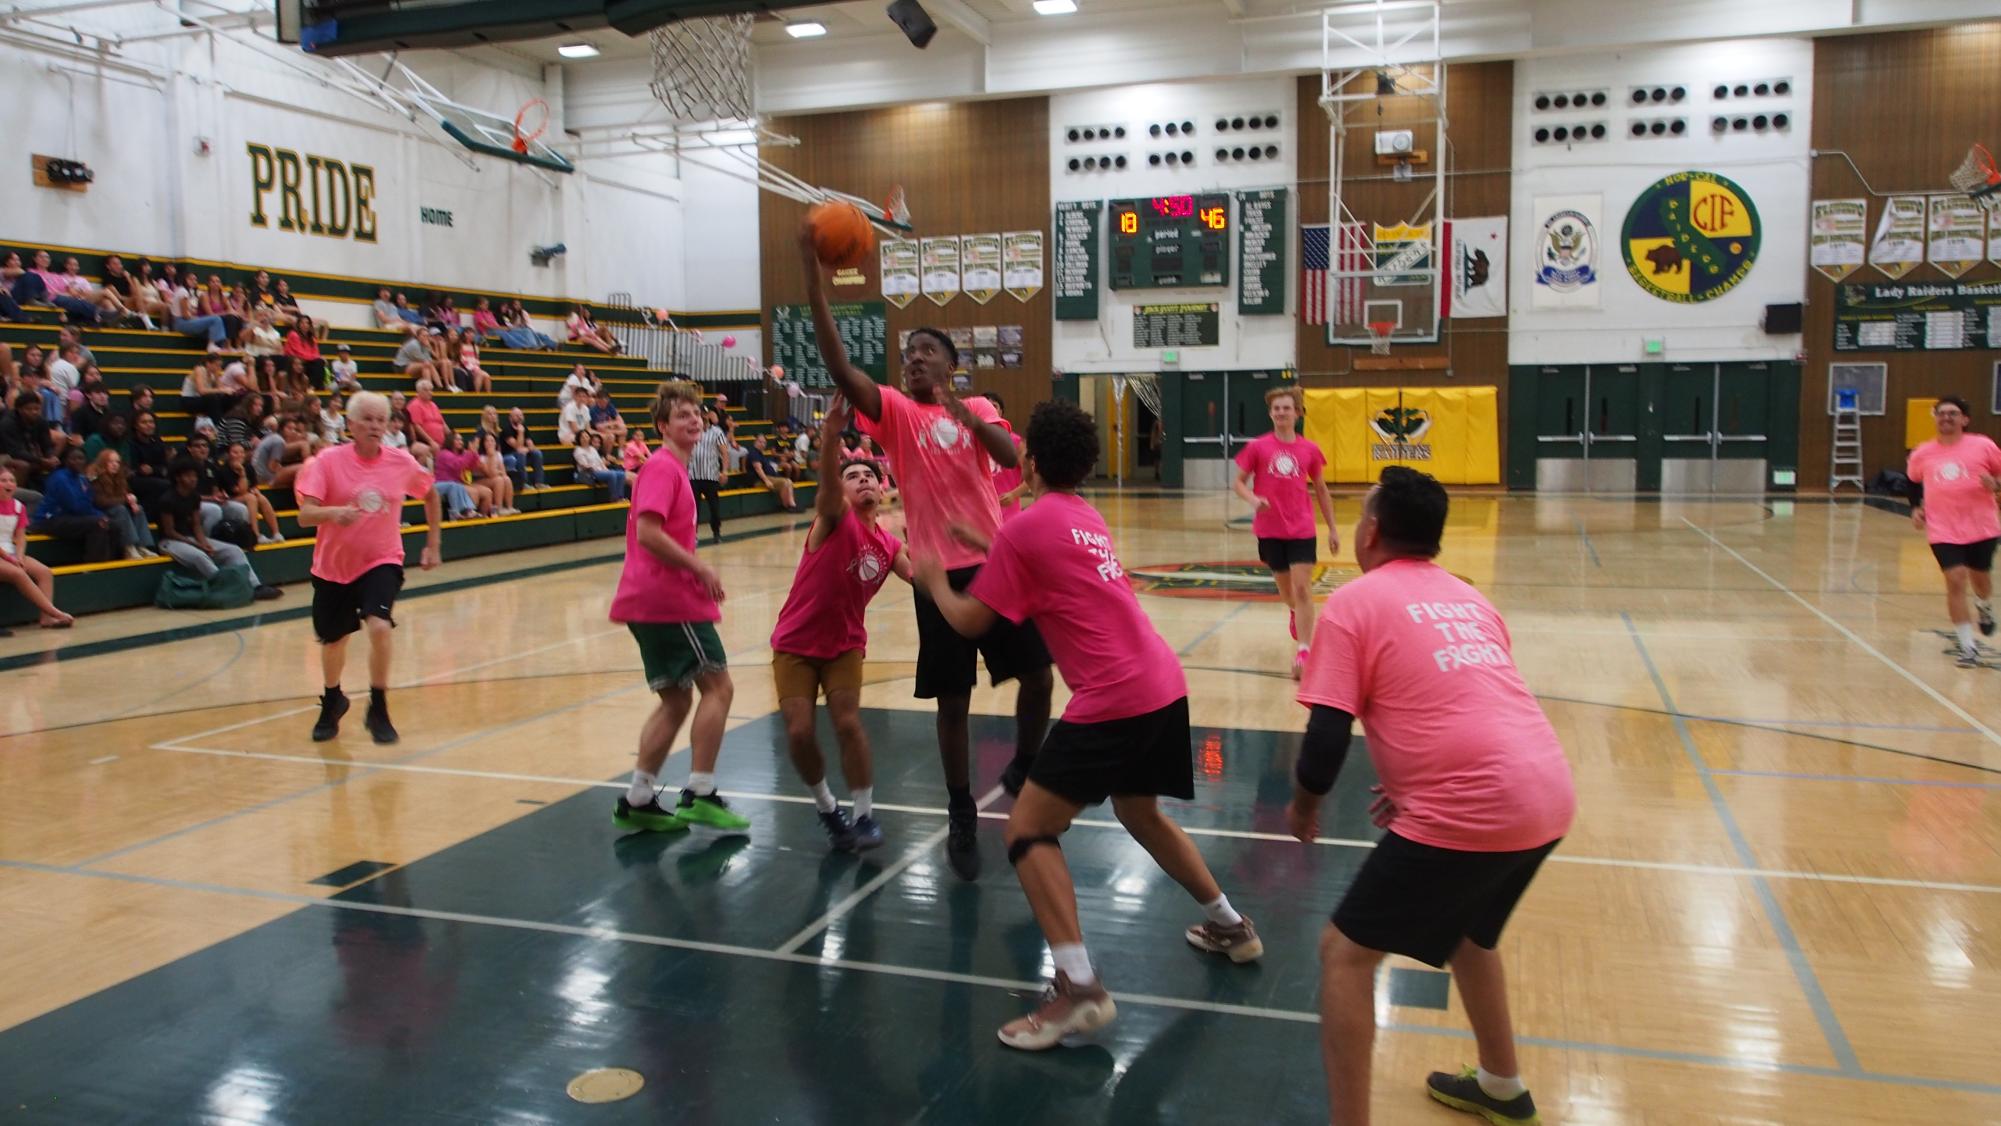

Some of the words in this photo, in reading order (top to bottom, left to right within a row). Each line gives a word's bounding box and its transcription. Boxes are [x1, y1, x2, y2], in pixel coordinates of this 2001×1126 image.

[246, 141, 379, 244] PRIDE
[420, 206, 454, 228] HOME
[1200, 207, 1225, 229] 46
[1694, 193, 1735, 232] CIF
[1875, 286, 1905, 299] Lady
[1907, 285, 1954, 297] Raiders
[1957, 283, 2001, 296] Basket
[1071, 528, 1111, 550] FIGHT
[1406, 602, 1483, 624] FIGHT
[1433, 621, 1487, 643] THE
